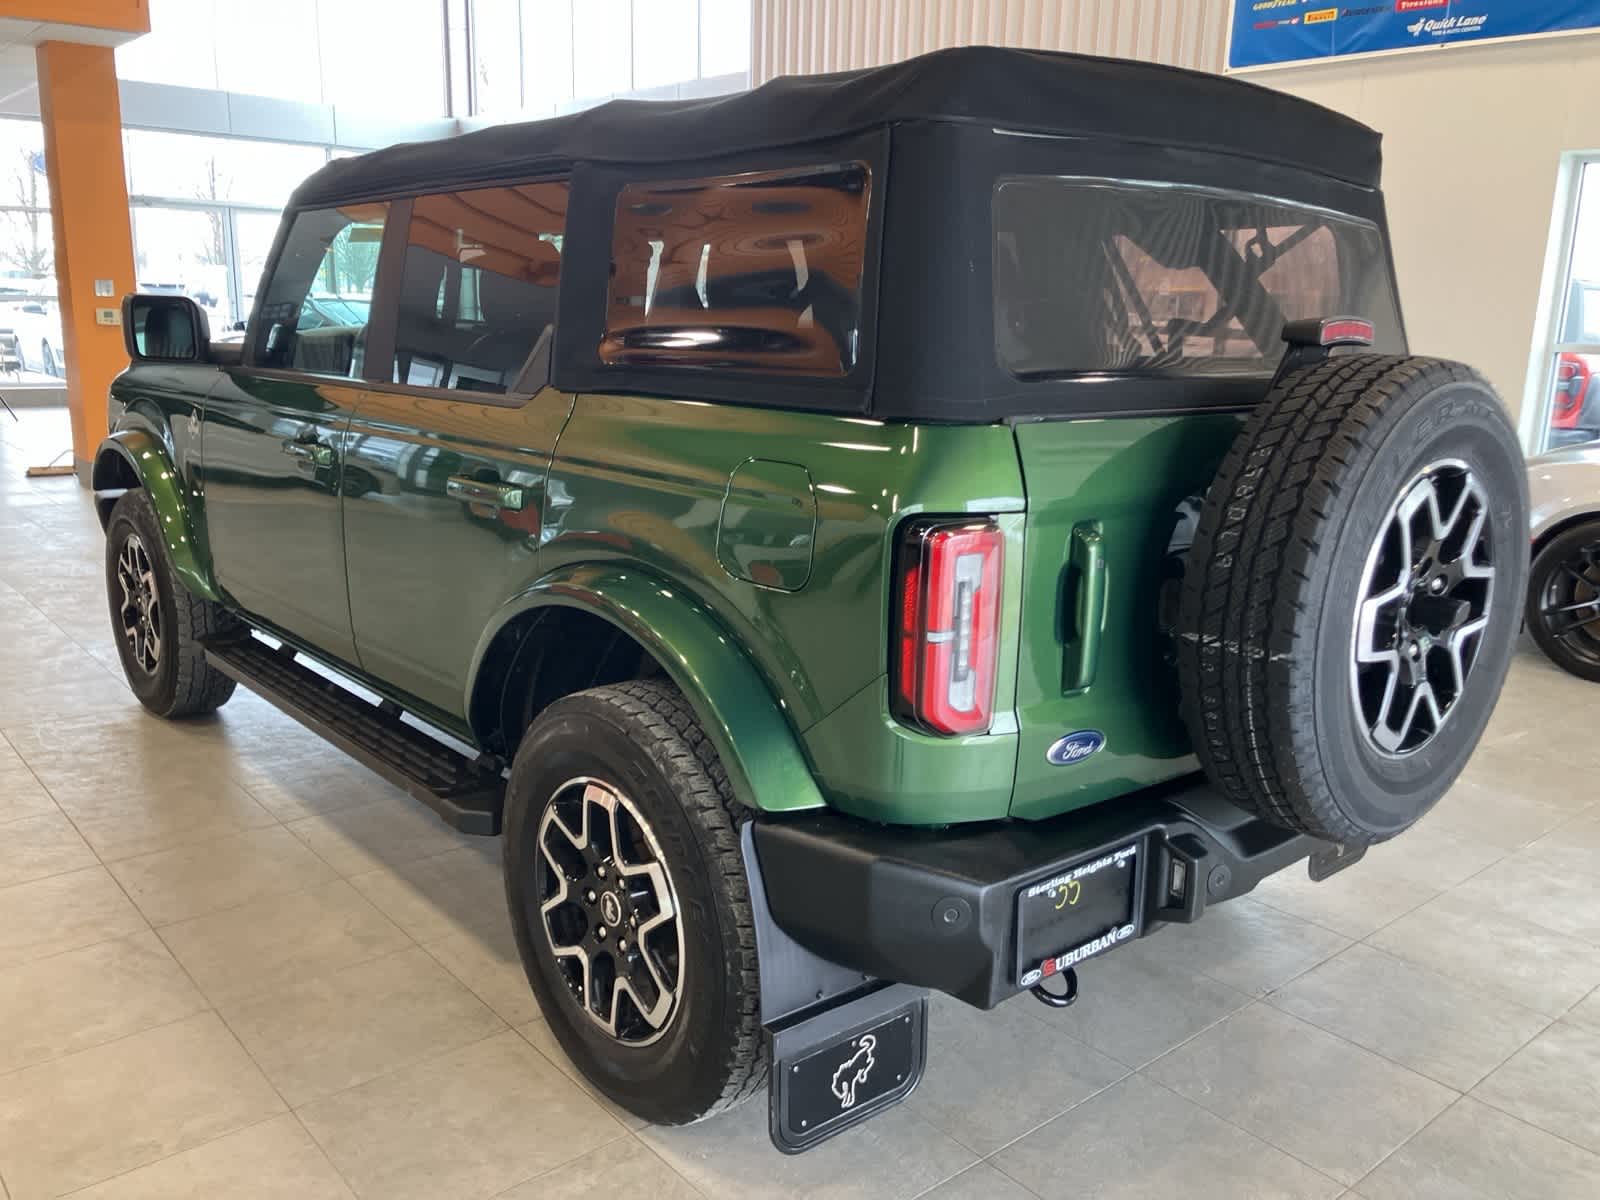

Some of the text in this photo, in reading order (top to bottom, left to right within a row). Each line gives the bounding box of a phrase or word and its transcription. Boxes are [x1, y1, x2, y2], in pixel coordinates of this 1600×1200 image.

[1424, 15, 1487, 32] Quick Lane
[1062, 740, 1094, 760] Ford
[1027, 845, 1136, 897] Sterling Heights Ford
[1042, 929, 1117, 977] SUBURBAN
